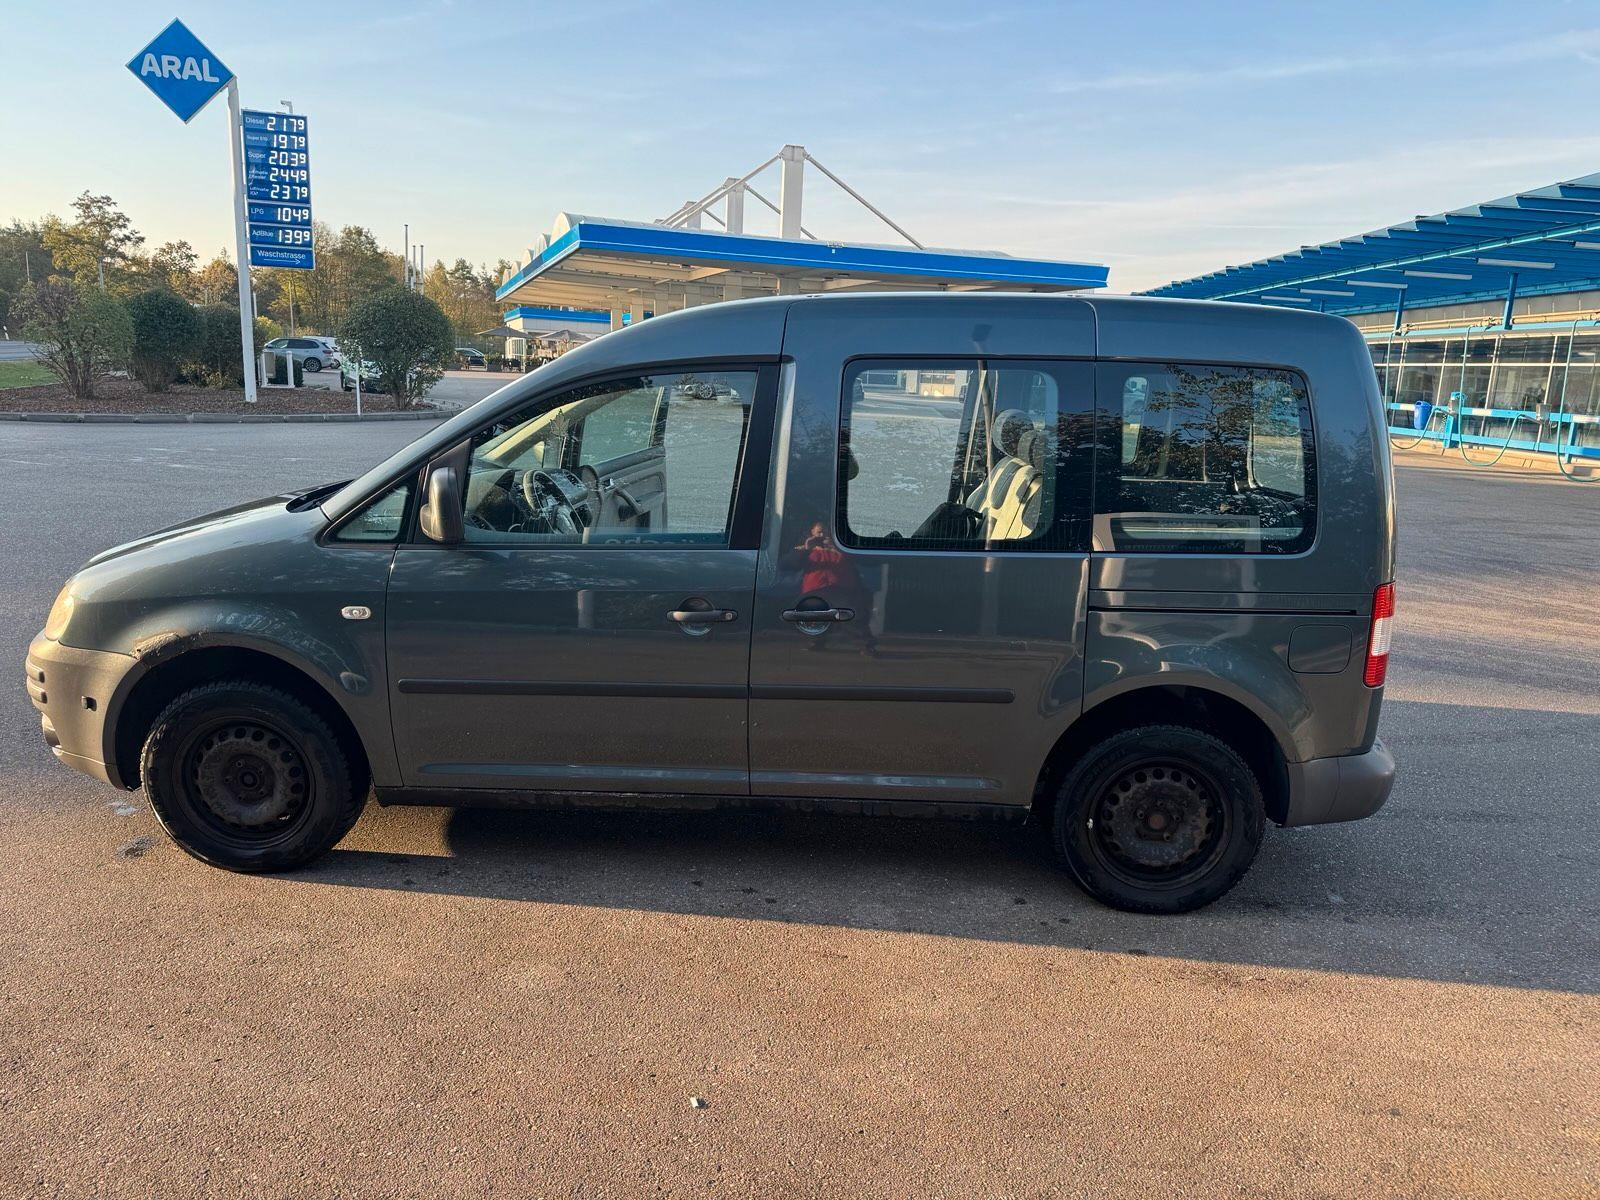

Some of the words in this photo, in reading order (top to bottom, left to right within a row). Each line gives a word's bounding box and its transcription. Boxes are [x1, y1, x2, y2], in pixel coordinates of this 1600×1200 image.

[140, 53, 219, 83] ARAL
[245, 116, 265, 124] Diesel
[267, 116, 305, 132] 2179
[273, 134, 306, 150] 1979
[248, 151, 266, 159] Super
[268, 151, 306, 166] 2039
[269, 167, 307, 183] 2449
[270, 184, 308, 200] 2379
[251, 207, 264, 215] LPG
[277, 207, 309, 222] 1049
[278, 229, 310, 244] 1399
[257, 250, 306, 259] Waschstrasse
